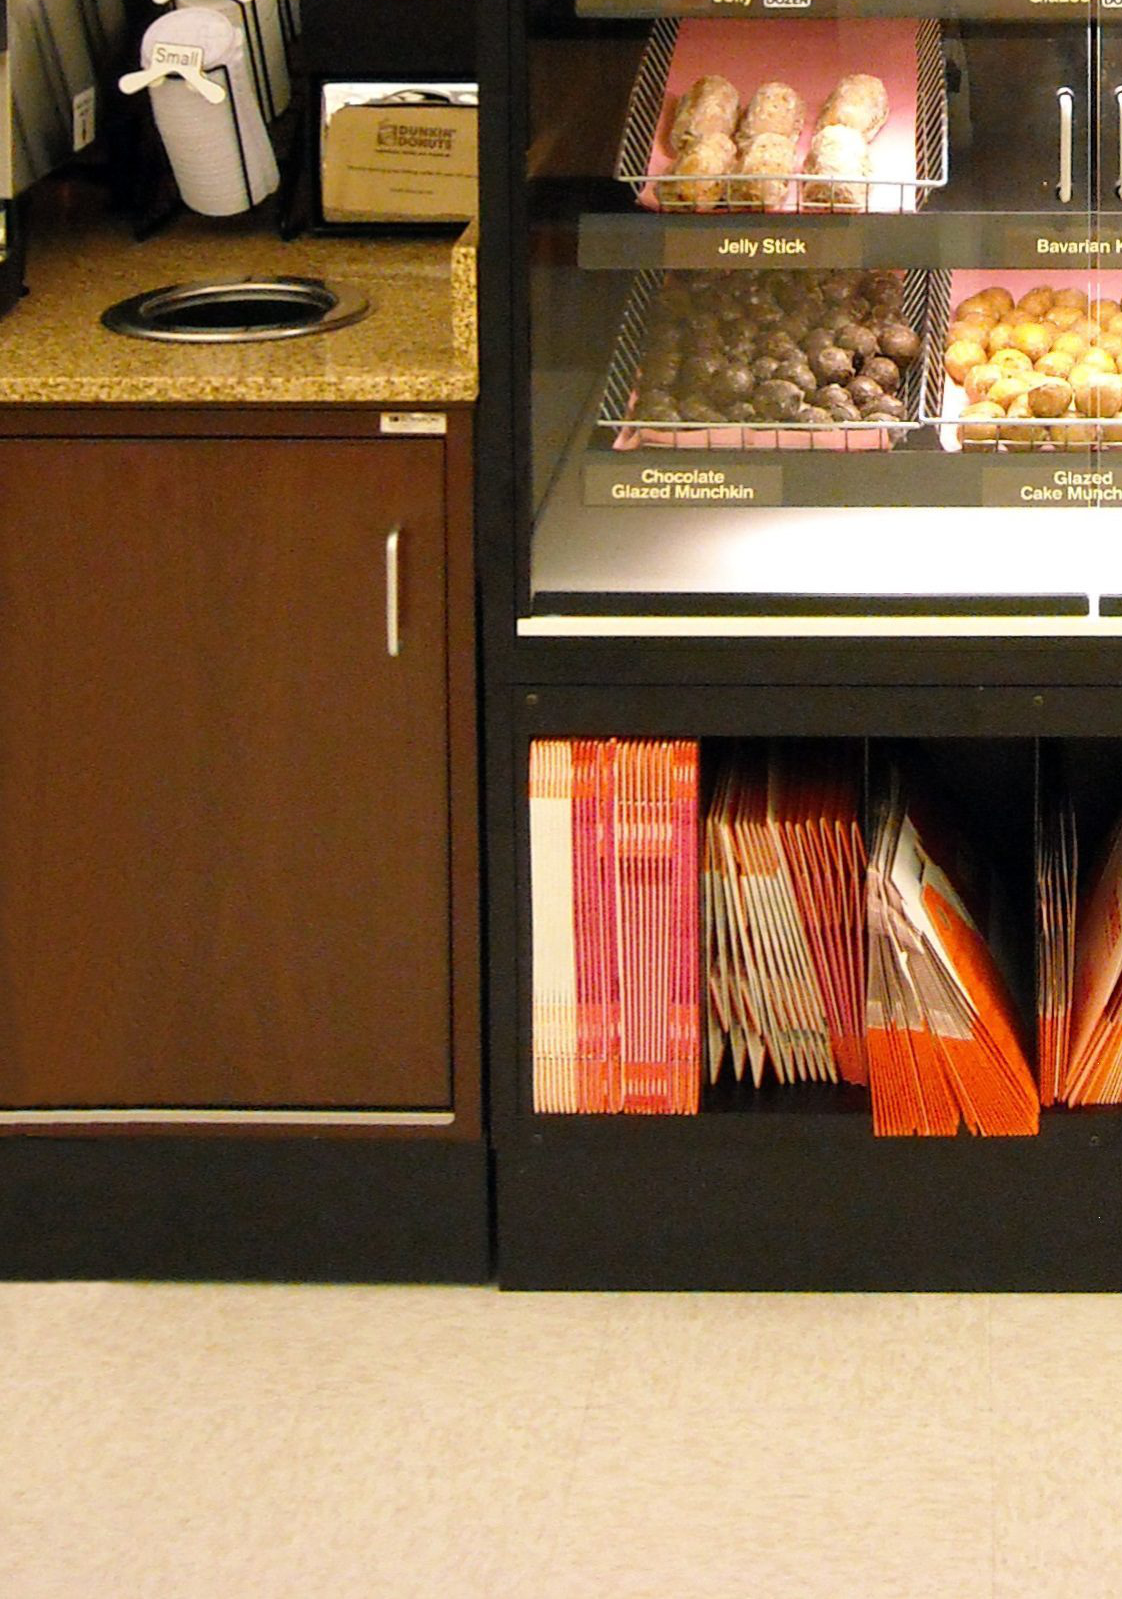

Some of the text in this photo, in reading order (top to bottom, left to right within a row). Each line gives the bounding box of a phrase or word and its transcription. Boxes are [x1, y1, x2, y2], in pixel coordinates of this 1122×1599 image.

[155, 46, 200, 68] Small
[718, 238, 806, 258] Jelly Stick
[1036, 237, 1110, 255] Bavarian
[641, 469, 725, 484] Chocolate
[1052, 469, 1114, 486] Glazed
[610, 483, 756, 500] Glazed Munchkin
[1019, 484, 1064, 501] Cake
